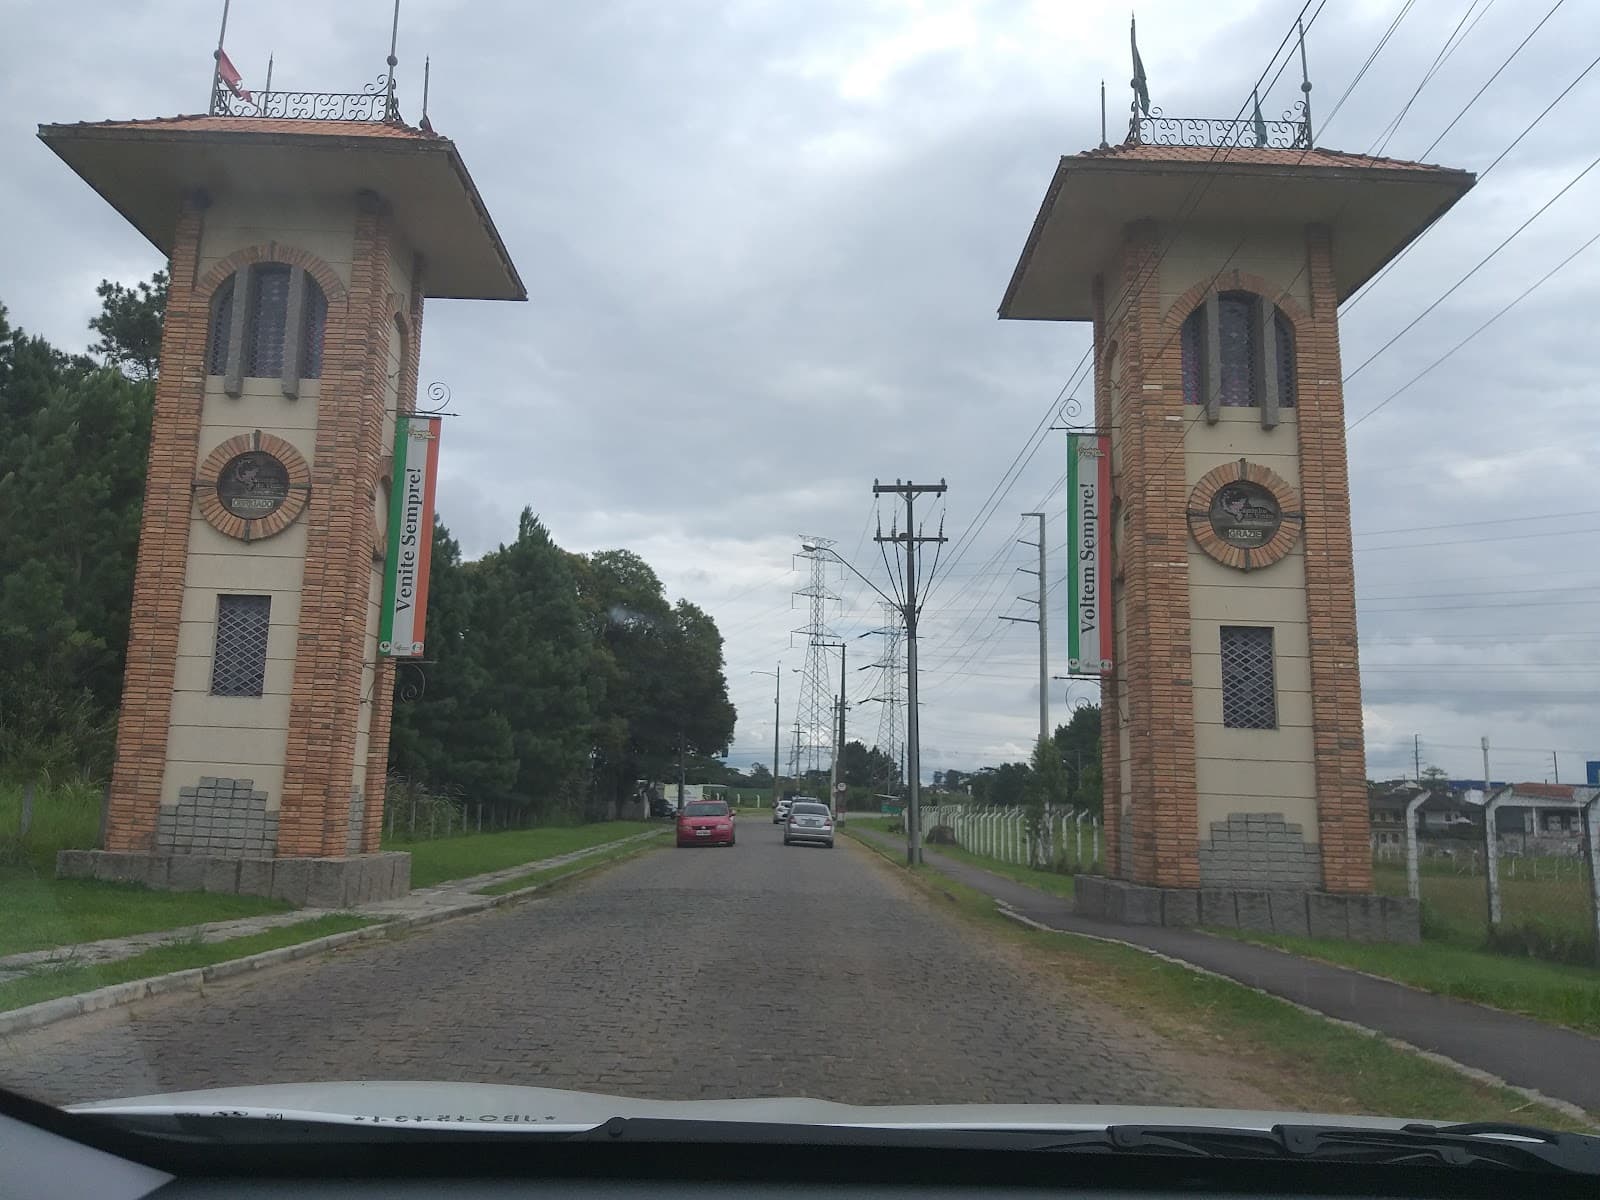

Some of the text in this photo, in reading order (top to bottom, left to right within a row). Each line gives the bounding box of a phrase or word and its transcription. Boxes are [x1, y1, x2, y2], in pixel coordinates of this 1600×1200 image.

[396, 468, 422, 613] Venite Sempre!
[1080, 483, 1097, 634] Voltem Sempre!
